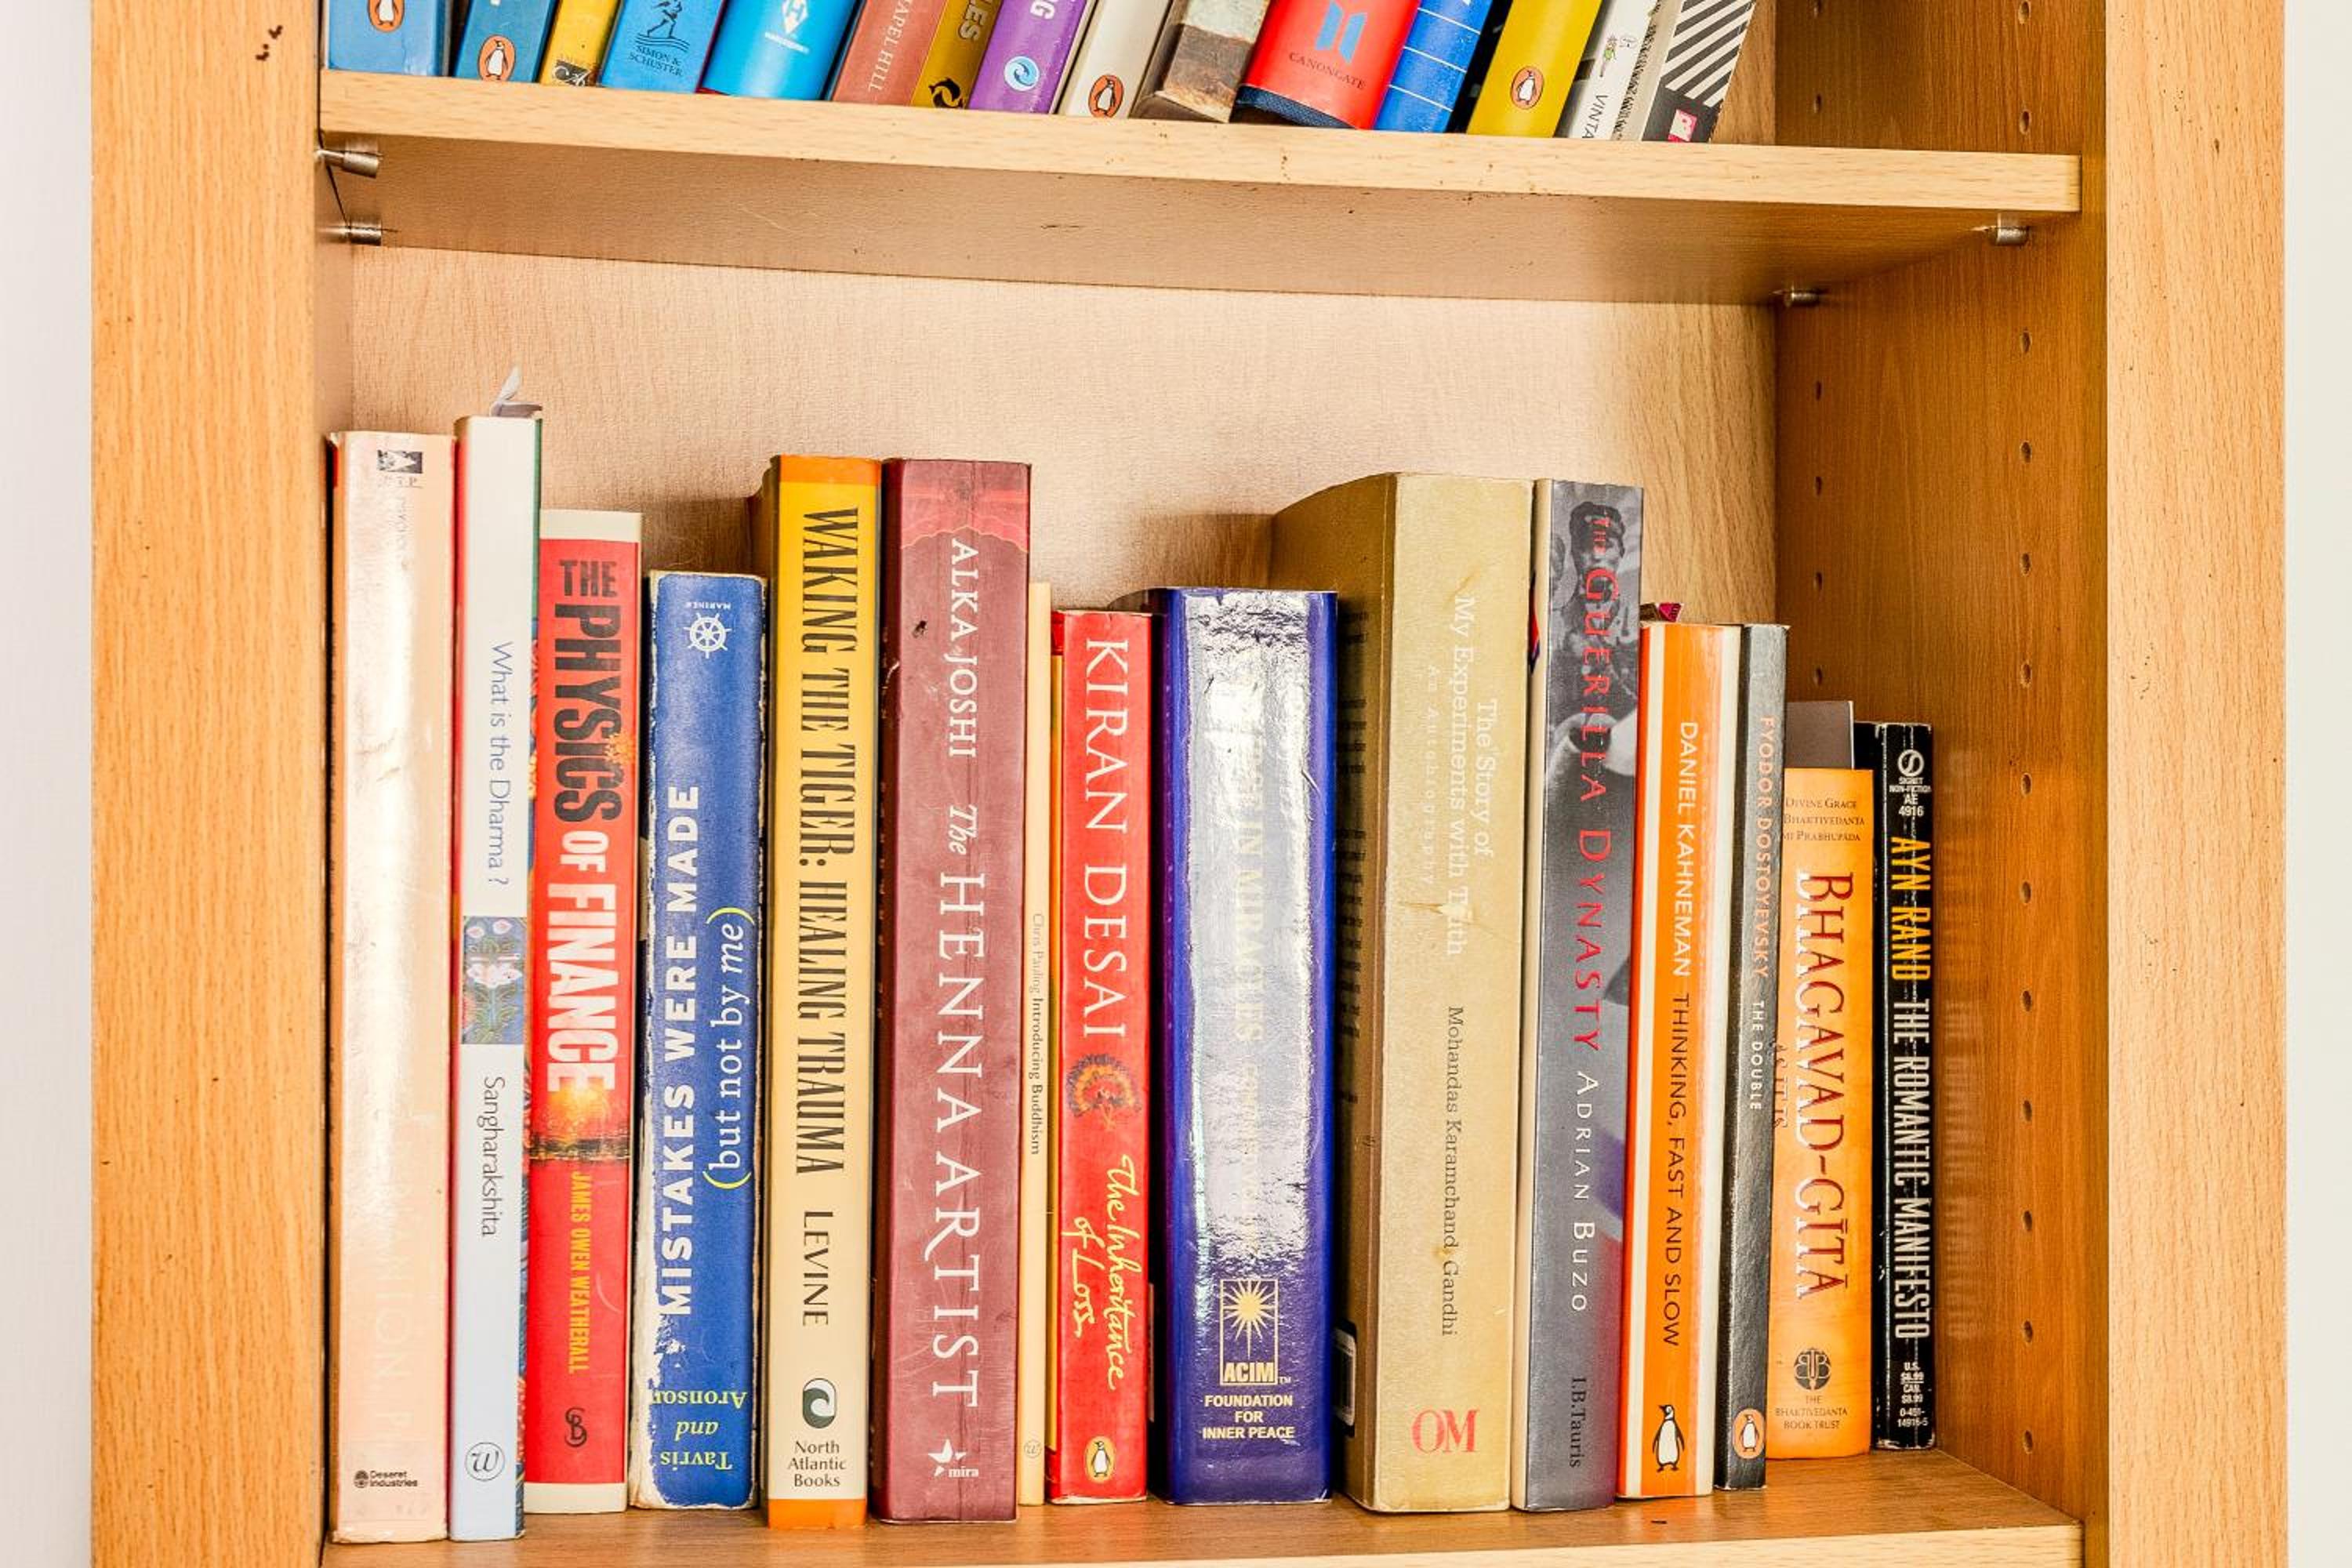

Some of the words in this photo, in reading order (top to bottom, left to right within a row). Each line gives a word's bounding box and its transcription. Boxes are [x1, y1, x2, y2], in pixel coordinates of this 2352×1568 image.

[628, 53, 683, 76] SCHUSTER
[868, 49, 895, 93] HILL
[1288, 52, 1367, 90] CANONGATE
[559, 560, 618, 597] THE
[801, 508, 858, 654] WAKING
[950, 538, 979, 643] ALKA
[1450, 595, 1475, 637] My
[491, 641, 514, 705] What
[800, 667, 849, 731] THE
[944, 653, 978, 759] JOSHI
[490, 713, 512, 728] is
[554, 604, 623, 823] PHYSICS
[1084, 639, 1129, 834] KIRAN
[1449, 646, 1475, 811] Experiments
[1476, 698, 1497, 746] The
[489, 736, 512, 771] the
[1677, 721, 1699, 815] DANIEL
[1756, 717, 1776, 808] FYODOR
[799, 743, 855, 867] TIGER:
[1470, 756, 1499, 823] Story
[1785, 797, 1823, 808] DIVINE
[1824, 797, 1857, 809] GRACE
[1898, 805, 1925, 816] 4916
[488, 780, 511, 869] Dharma
[560, 829, 610, 873] OF
[667, 786, 699, 913] MADE
[949, 804, 978, 856] The
[1448, 818, 1469, 878] with
[1474, 833, 1494, 858] of
[1890, 837, 1932, 891] AYN
[1032, 913, 1045, 948] Chris
[1671, 823, 1696, 978] KAHNEMAN
[1752, 818, 1774, 978] DOSTOYEVSKY
[706, 907, 755, 975] me)
[797, 880, 848, 1020] HEALING
[1083, 865, 1128, 1037] DESAI
[1573, 829, 1612, 1052] DYNASTY
[1890, 906, 1932, 982] RAND
[547, 883, 619, 1092] FINANCE
[664, 936, 697, 1062] WERE
[710, 986, 750, 1028] by
[936, 872, 986, 1134] HENNA
[1751, 1000, 1765, 1032] THE
[1028, 996, 1044, 1080] Introducing
[1893, 998, 1930, 1045] THE
[717, 1038, 743, 1099] not
[1445, 1006, 1465, 1113] Mohandas
[1667, 993, 1690, 1126] THINKING,
[1749, 1040, 1764, 1111] DOUBLE
[796, 1032, 845, 1174] TRAUMA
[1030, 1083, 1044, 1156] Buddhism
[1573, 1070, 1600, 1200] ADRIAN
[1893, 1055, 1931, 1186] ROMANTIC
[477, 1076, 505, 1237] Sangharakshita
[702, 1111, 752, 1189] (but
[1667, 1137, 1686, 1199] FAST
[569, 1171, 593, 1223] JAMES
[661, 1084, 696, 1317] MISTAKES
[1106, 1154, 1140, 1221] The
[1443, 1120, 1463, 1249] Karamchand
[568, 1227, 591, 1272] OWEN
[1062, 1216, 1106, 1250] of
[1664, 1206, 1684, 1264] AND
[802, 1210, 834, 1327] LEVINE
[924, 1150, 982, 1409] ARTIST
[1071, 1247, 1105, 1338] Loss
[1440, 1260, 1459, 1337] Gandhi
[1893, 1197, 1932, 1340] MANIFESTO
[568, 1275, 591, 1374] WEATHERALL
[1102, 1222, 1143, 1392] Inheritance
[1663, 1273, 1682, 1347] SLOW
[652, 1390, 748, 1410] Aronson
[1203, 1394, 1294, 1407] FOUNDATION
[1223, 1361, 1276, 1383] ACIM
[1805, 1395, 1824, 1404] THE
[674, 1421, 719, 1442] and
[793, 1439, 840, 1454] North
[1202, 1426, 1246, 1439] INNER
[1249, 1426, 1295, 1439] PEACE
[1235, 1410, 1265, 1423] FOR
[1410, 1409, 1480, 1454] OM
[1783, 1420, 1813, 1429] BOOK
[1813, 1420, 1841, 1429] TRUST
[369, 1470, 408, 1479] Deseret
[659, 1451, 733, 1472] Tavris
[787, 1456, 848, 1471] Atlantic
[793, 1473, 841, 1488] Books
[948, 1465, 979, 1478] mira
